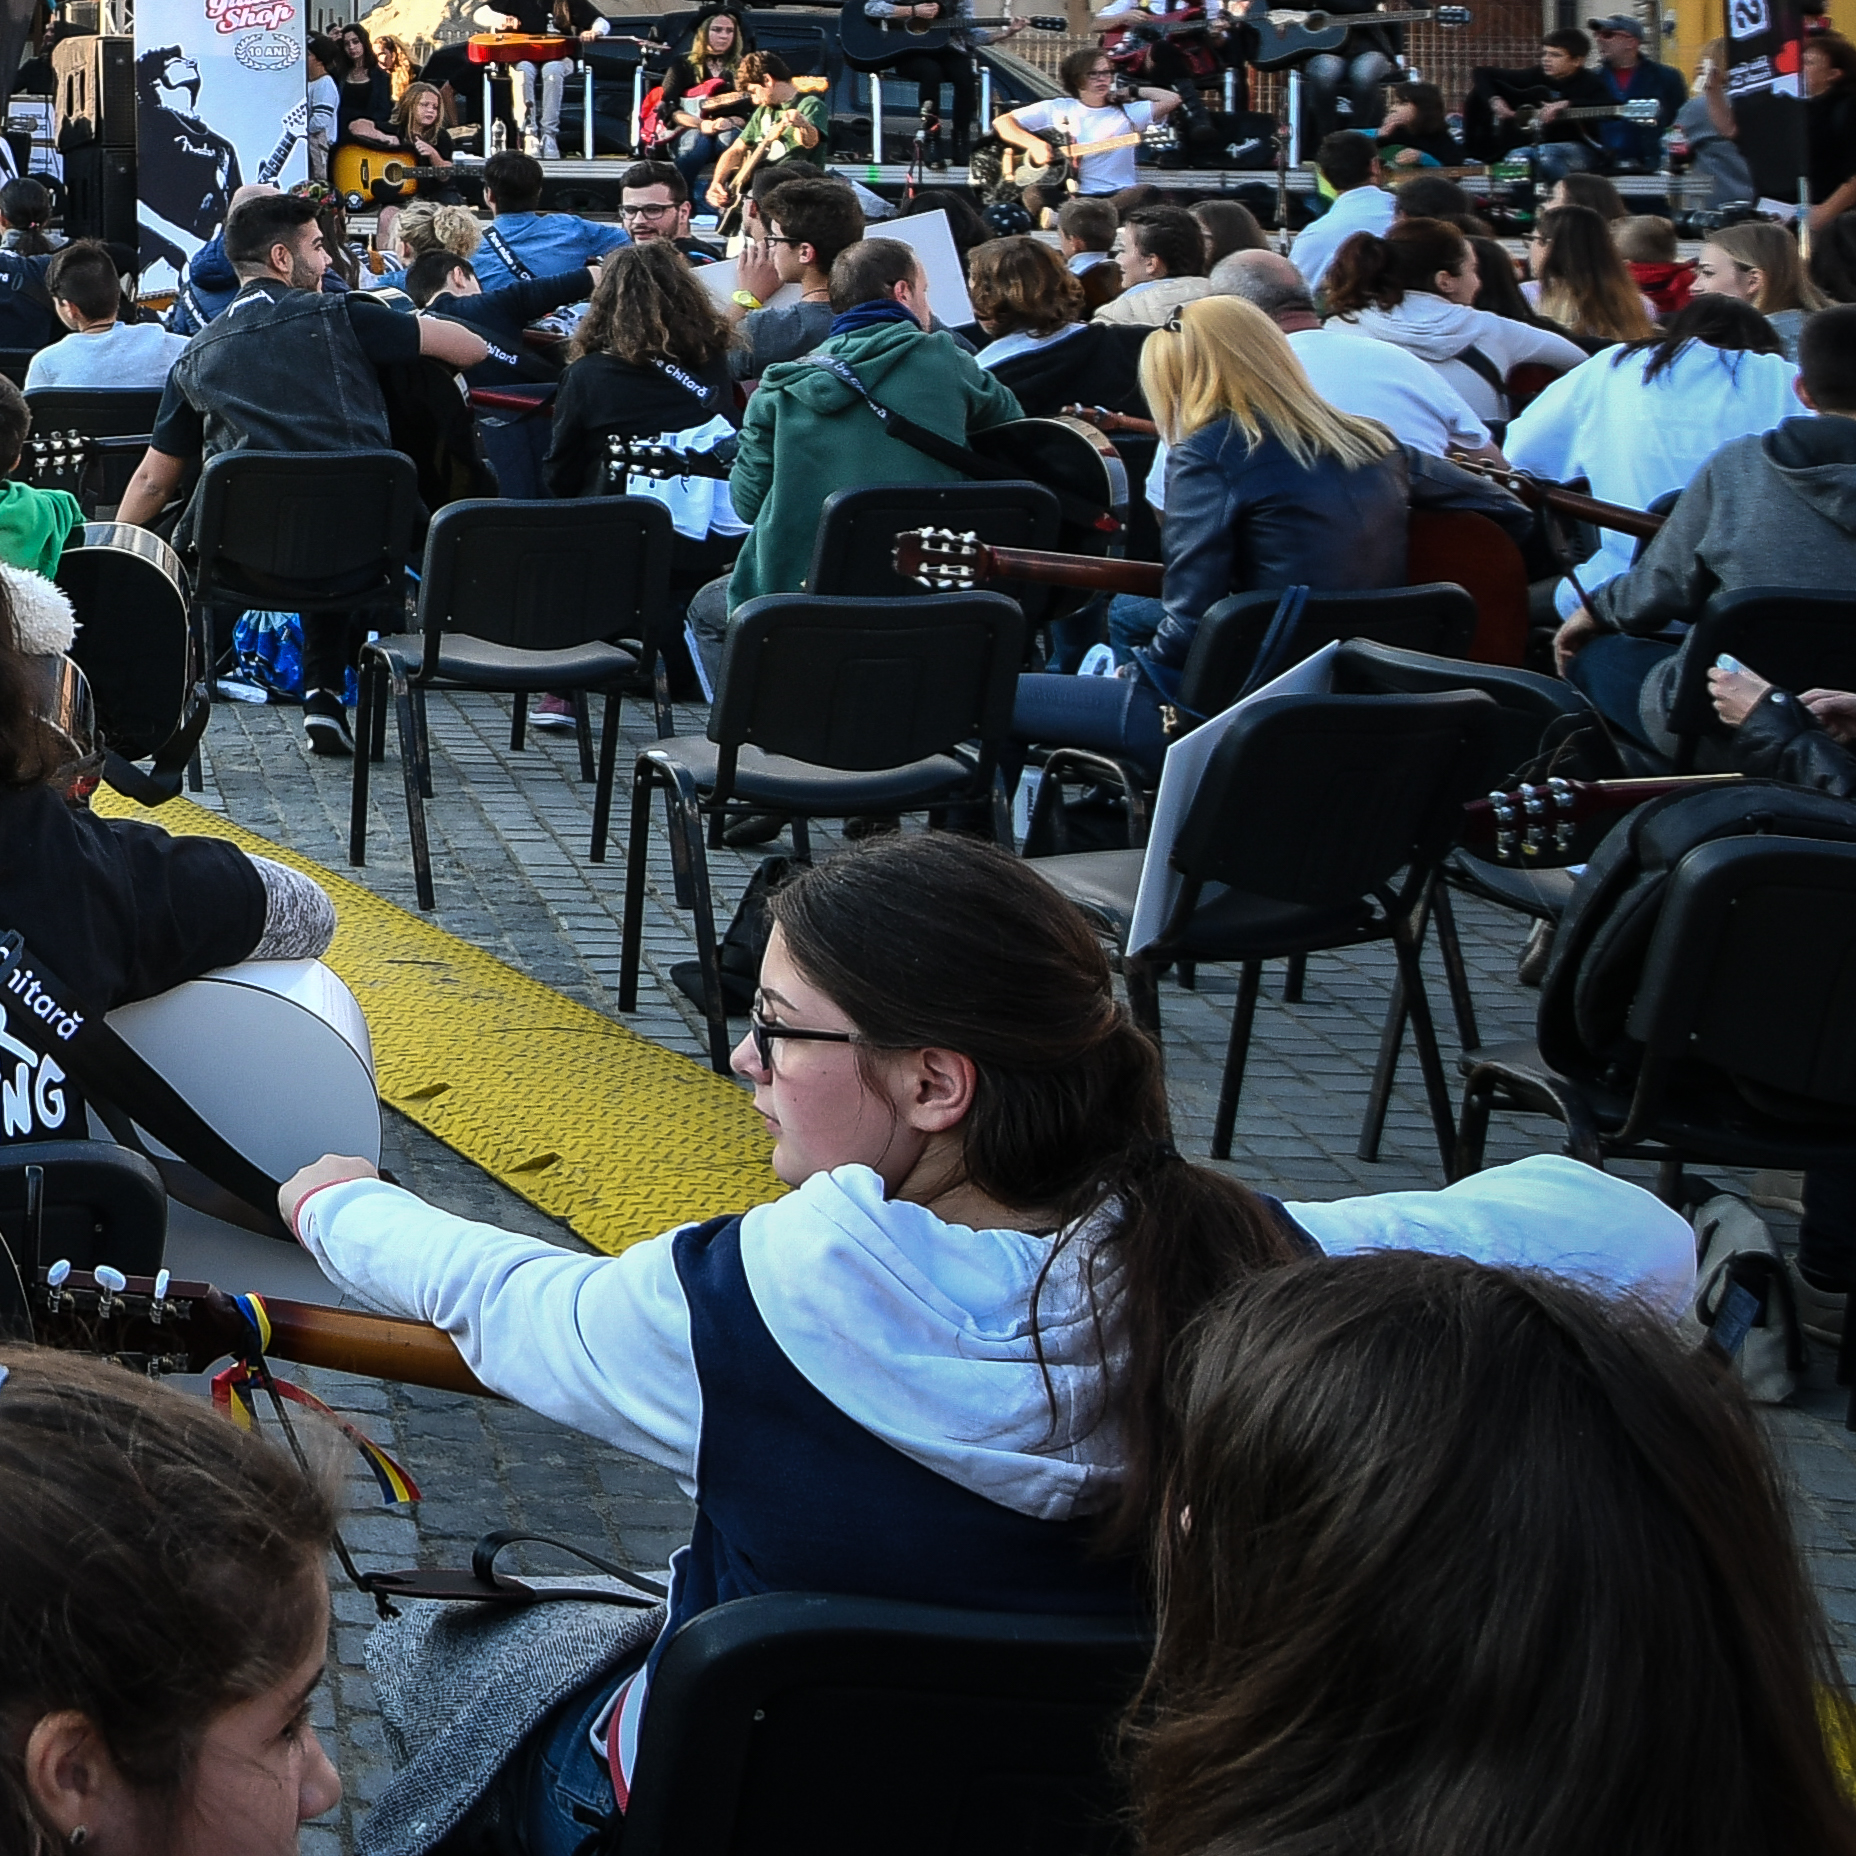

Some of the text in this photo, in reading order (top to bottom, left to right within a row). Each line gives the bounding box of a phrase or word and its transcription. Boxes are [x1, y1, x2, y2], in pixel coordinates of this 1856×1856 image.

[218, 2, 295, 32] Shop
[247, 44, 287, 59] 10 ANI
